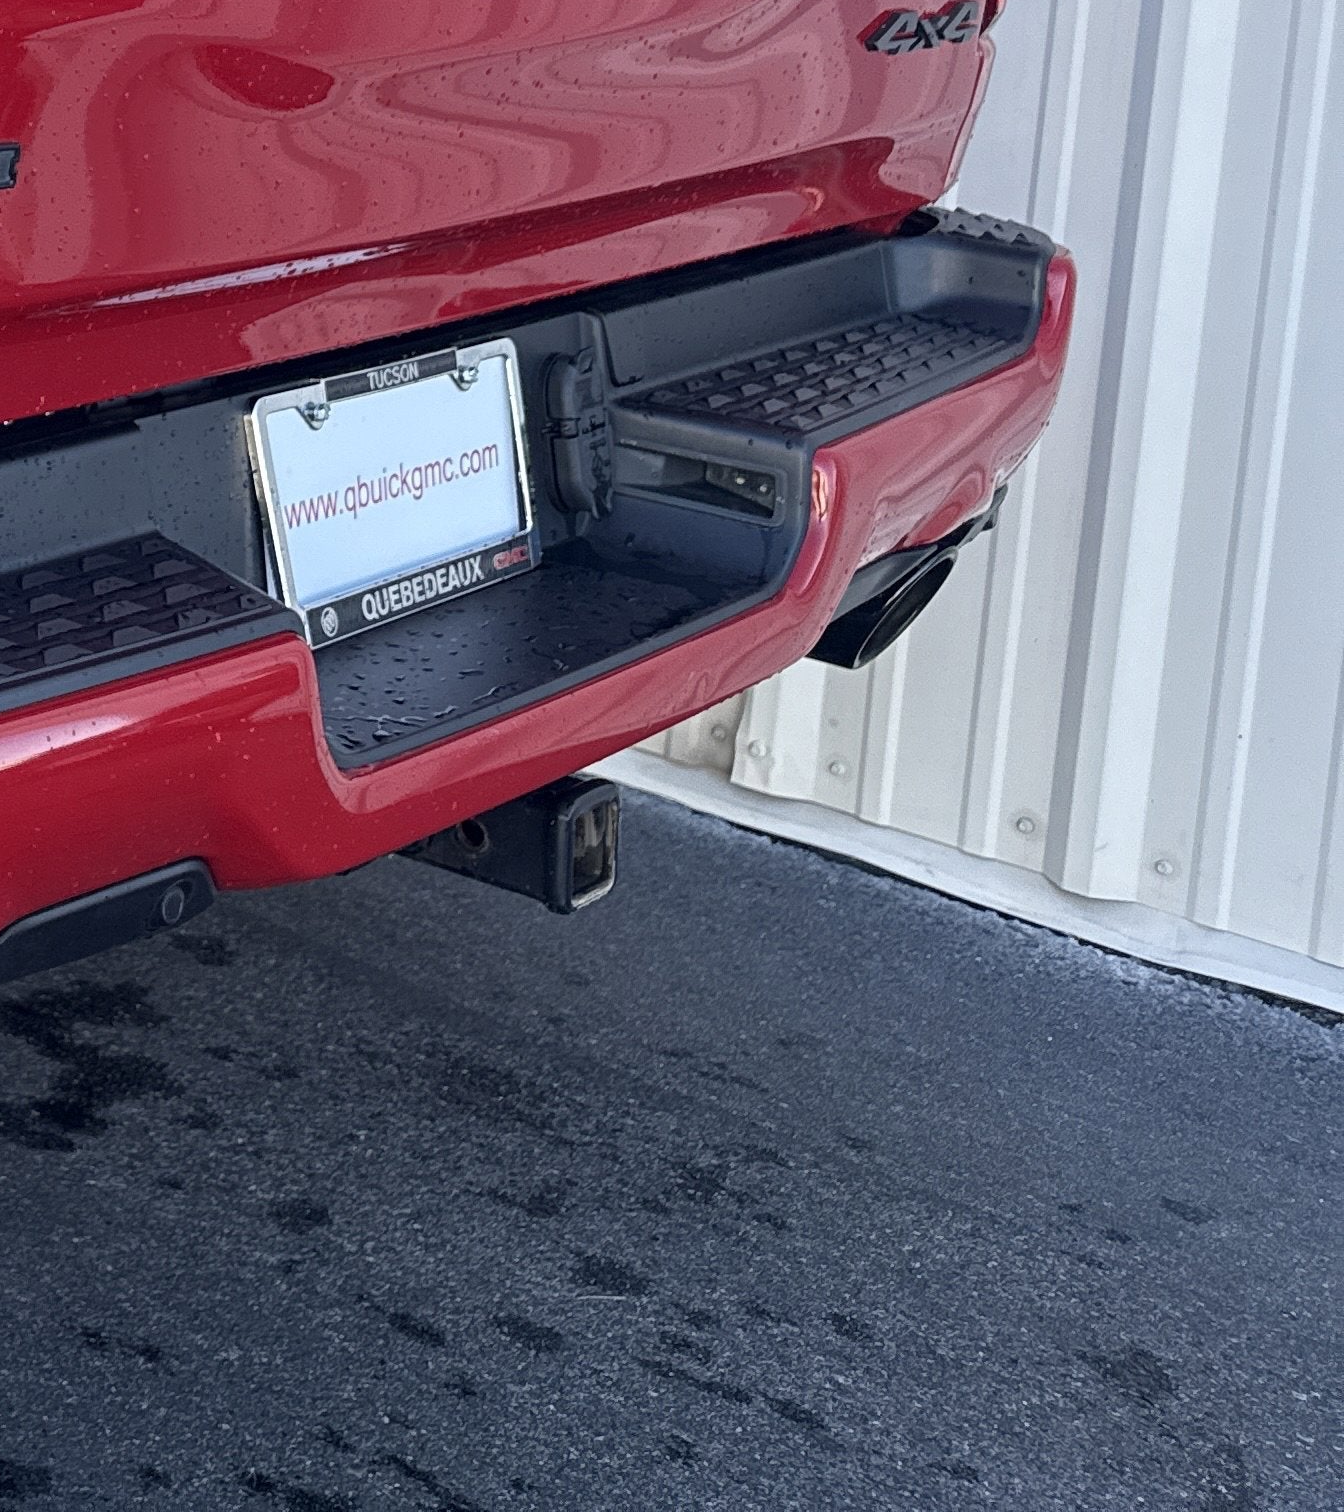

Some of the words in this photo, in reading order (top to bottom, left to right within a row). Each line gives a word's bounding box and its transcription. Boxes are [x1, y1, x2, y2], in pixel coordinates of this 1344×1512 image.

[366, 361, 419, 391] TUCSON
[284, 443, 499, 529] www.qbuickgmc.com
[362, 557, 485, 621] QUEBEDEAUX
[493, 544, 529, 570] GMC
